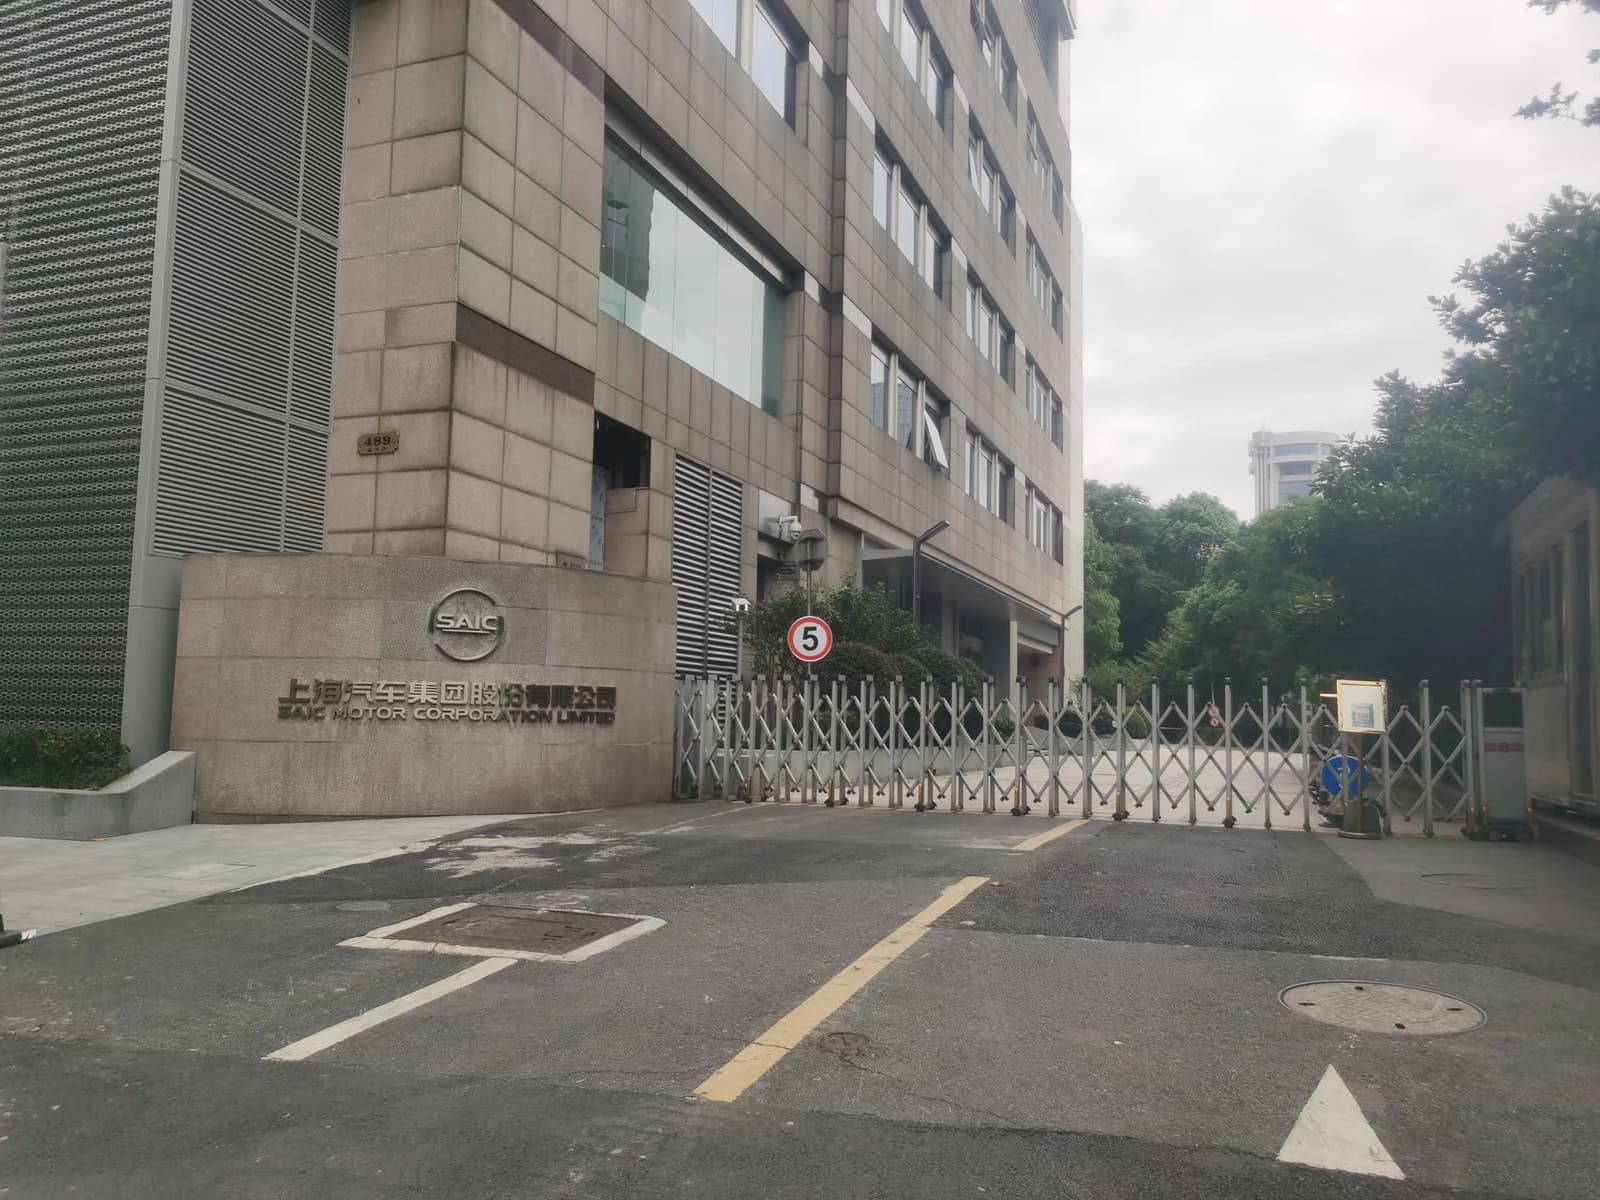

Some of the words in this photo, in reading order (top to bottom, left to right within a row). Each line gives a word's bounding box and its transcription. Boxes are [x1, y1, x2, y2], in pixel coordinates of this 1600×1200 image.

[436, 614, 499, 631] SAIC
[802, 626, 819, 651] 5
[278, 678, 616, 710] 上海汽车集团股份有限公司
[278, 706, 325, 721] SAIC
[332, 707, 407, 721] MOTOR
[414, 708, 553, 723] CORPORATION
[555, 711, 616, 724] LIMITED
